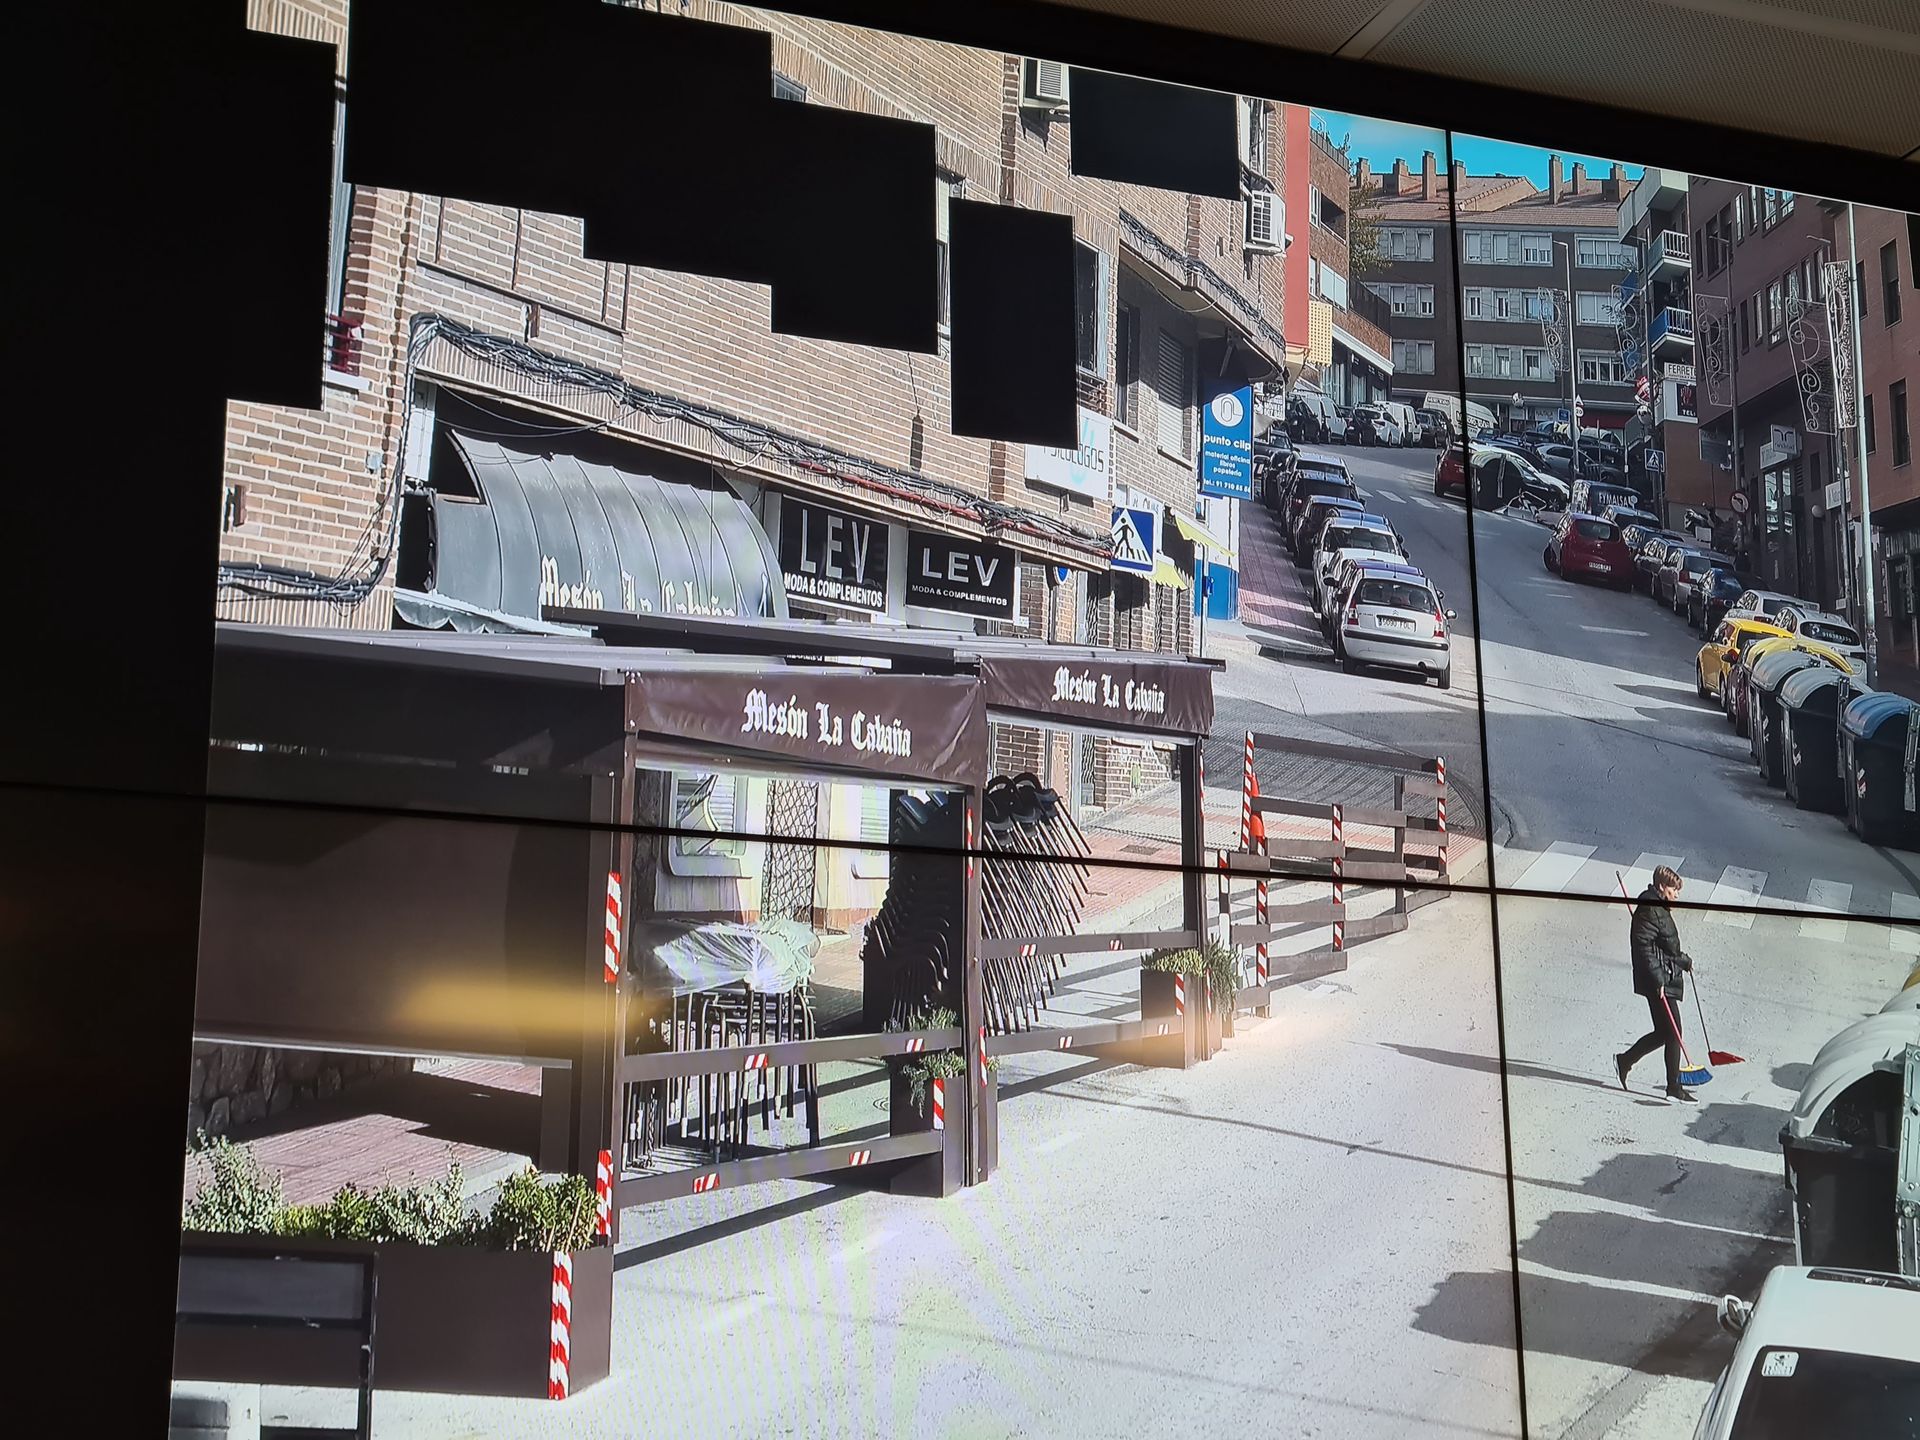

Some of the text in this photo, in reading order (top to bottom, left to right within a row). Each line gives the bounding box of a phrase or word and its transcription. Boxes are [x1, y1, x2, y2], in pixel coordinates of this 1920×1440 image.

[1043, 443, 1104, 473] COLOGOS
[1204, 434, 1250, 450] punto clip
[1205, 450, 1250, 464] material oficina
[1219, 460, 1236, 468] libros
[800, 509, 870, 583] LEV
[922, 548, 999, 587] LEV
[784, 572, 883, 608] MODA & COMPLEMENTOS
[912, 585, 935, 596] MODA
[943, 590, 1008, 606] COMPLEMENTOS
[1051, 665, 1165, 714] Mesón La Cabaña
[741, 688, 911, 757] Mesón La Cabaña
